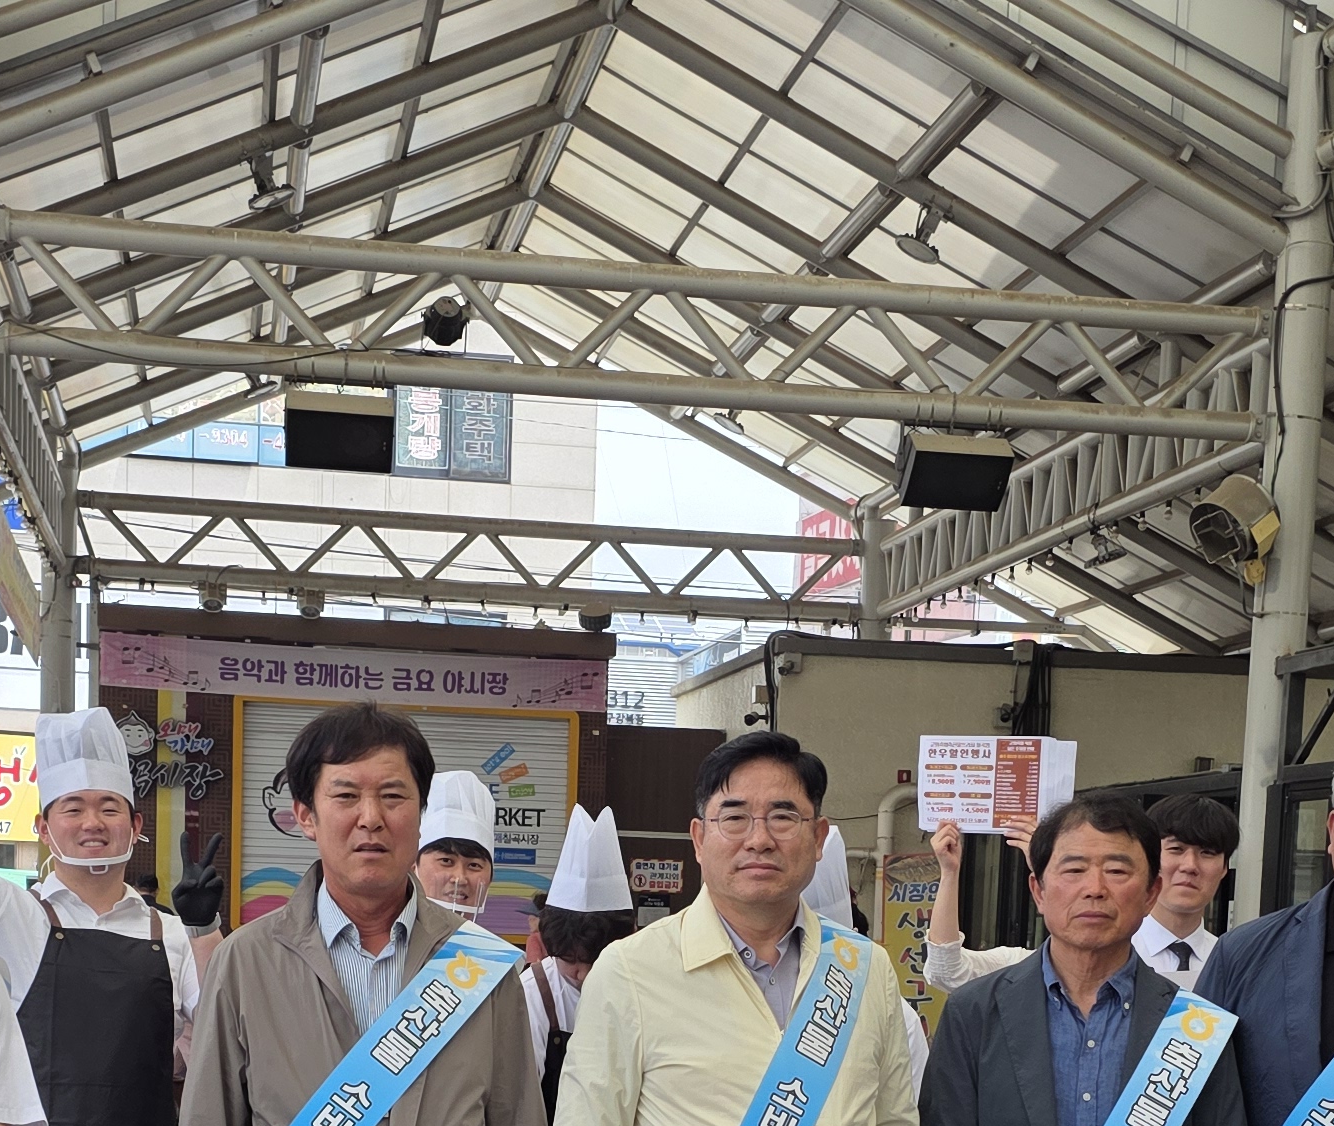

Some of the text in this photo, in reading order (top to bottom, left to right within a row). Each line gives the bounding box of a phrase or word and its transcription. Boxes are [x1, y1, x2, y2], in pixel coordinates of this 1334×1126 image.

[218, 656, 510, 696] 음악과 함께하는 금요 야시장
[157, 719, 201, 740] 오매
[166, 737, 214, 755] 가매
[127, 758, 224, 800] 곡시장
[495, 807, 546, 828] RKET
[897, 907, 934, 1037] 생선구
[370, 978, 462, 1076] 축산물
[795, 963, 853, 1068] 축산물
